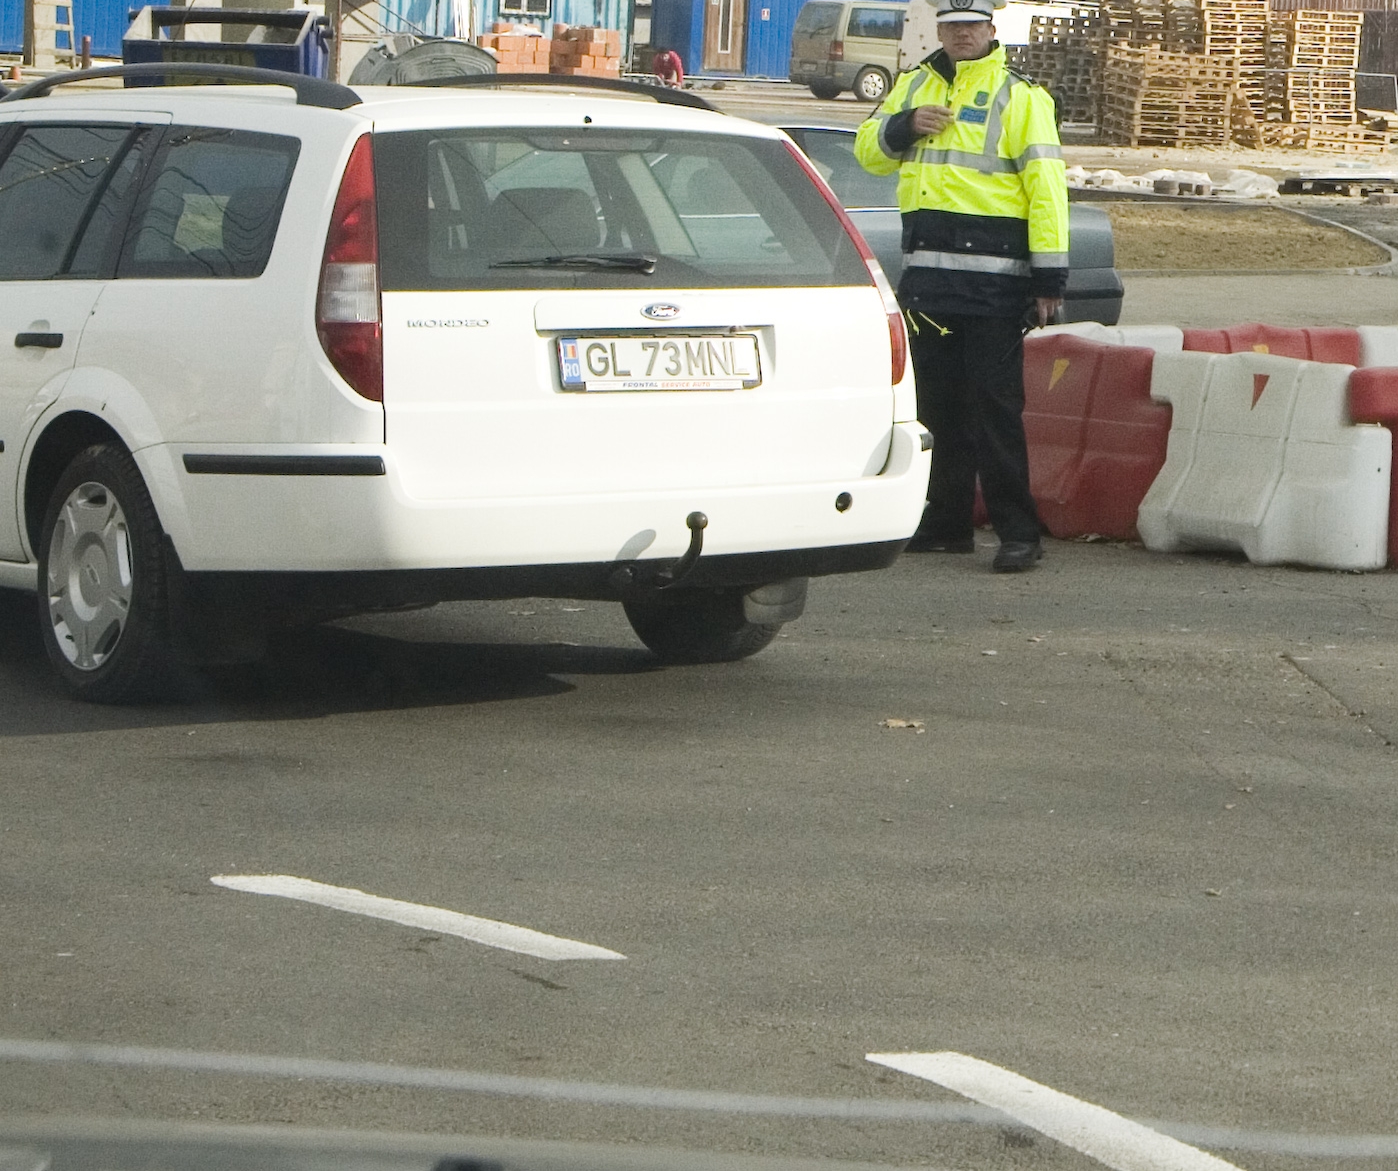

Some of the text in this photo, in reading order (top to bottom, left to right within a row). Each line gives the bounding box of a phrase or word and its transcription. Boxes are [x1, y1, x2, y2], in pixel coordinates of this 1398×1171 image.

[407, 319, 489, 328] MONDEO
[586, 342, 632, 377] GL
[564, 363, 580, 377] RO
